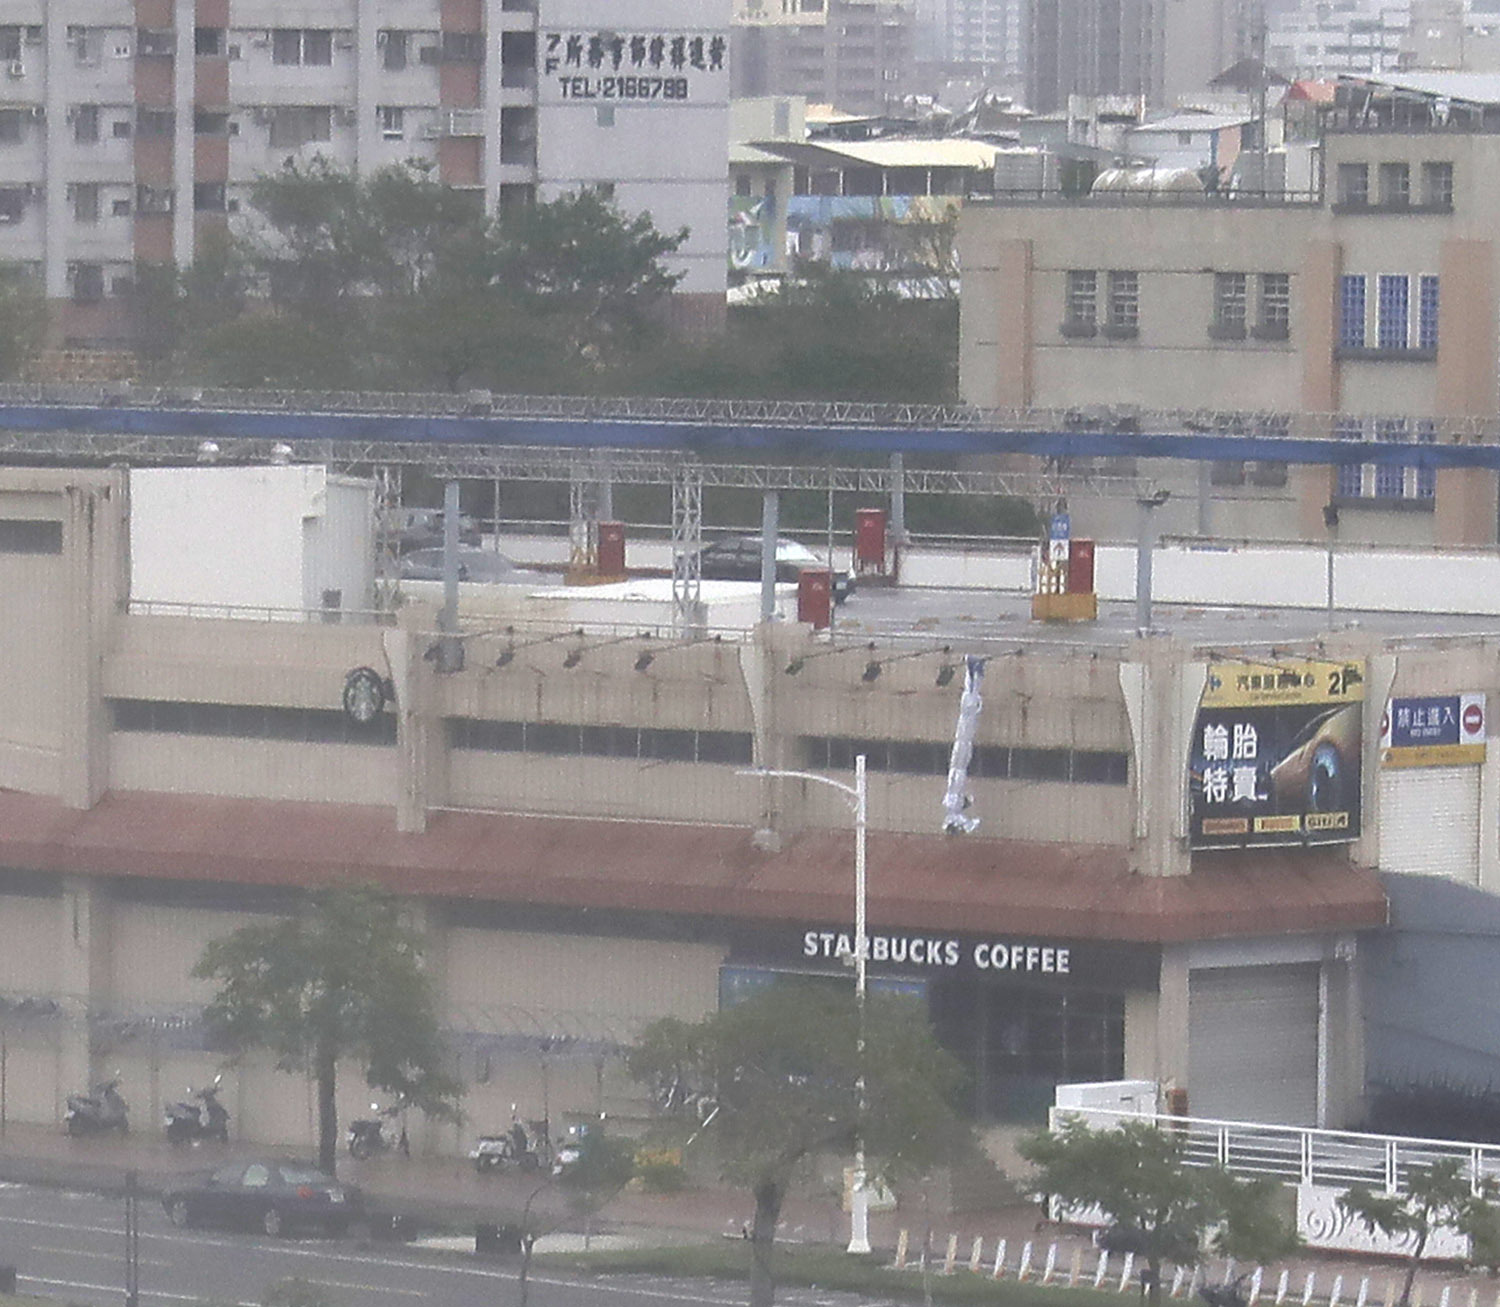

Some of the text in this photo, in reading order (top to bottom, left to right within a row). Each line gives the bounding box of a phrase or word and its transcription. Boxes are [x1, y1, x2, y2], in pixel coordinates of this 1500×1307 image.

[1203, 722, 1258, 761] 輪胎
[1203, 766, 1258, 803] 特賣
[973, 944, 1071, 973] COFFEE
